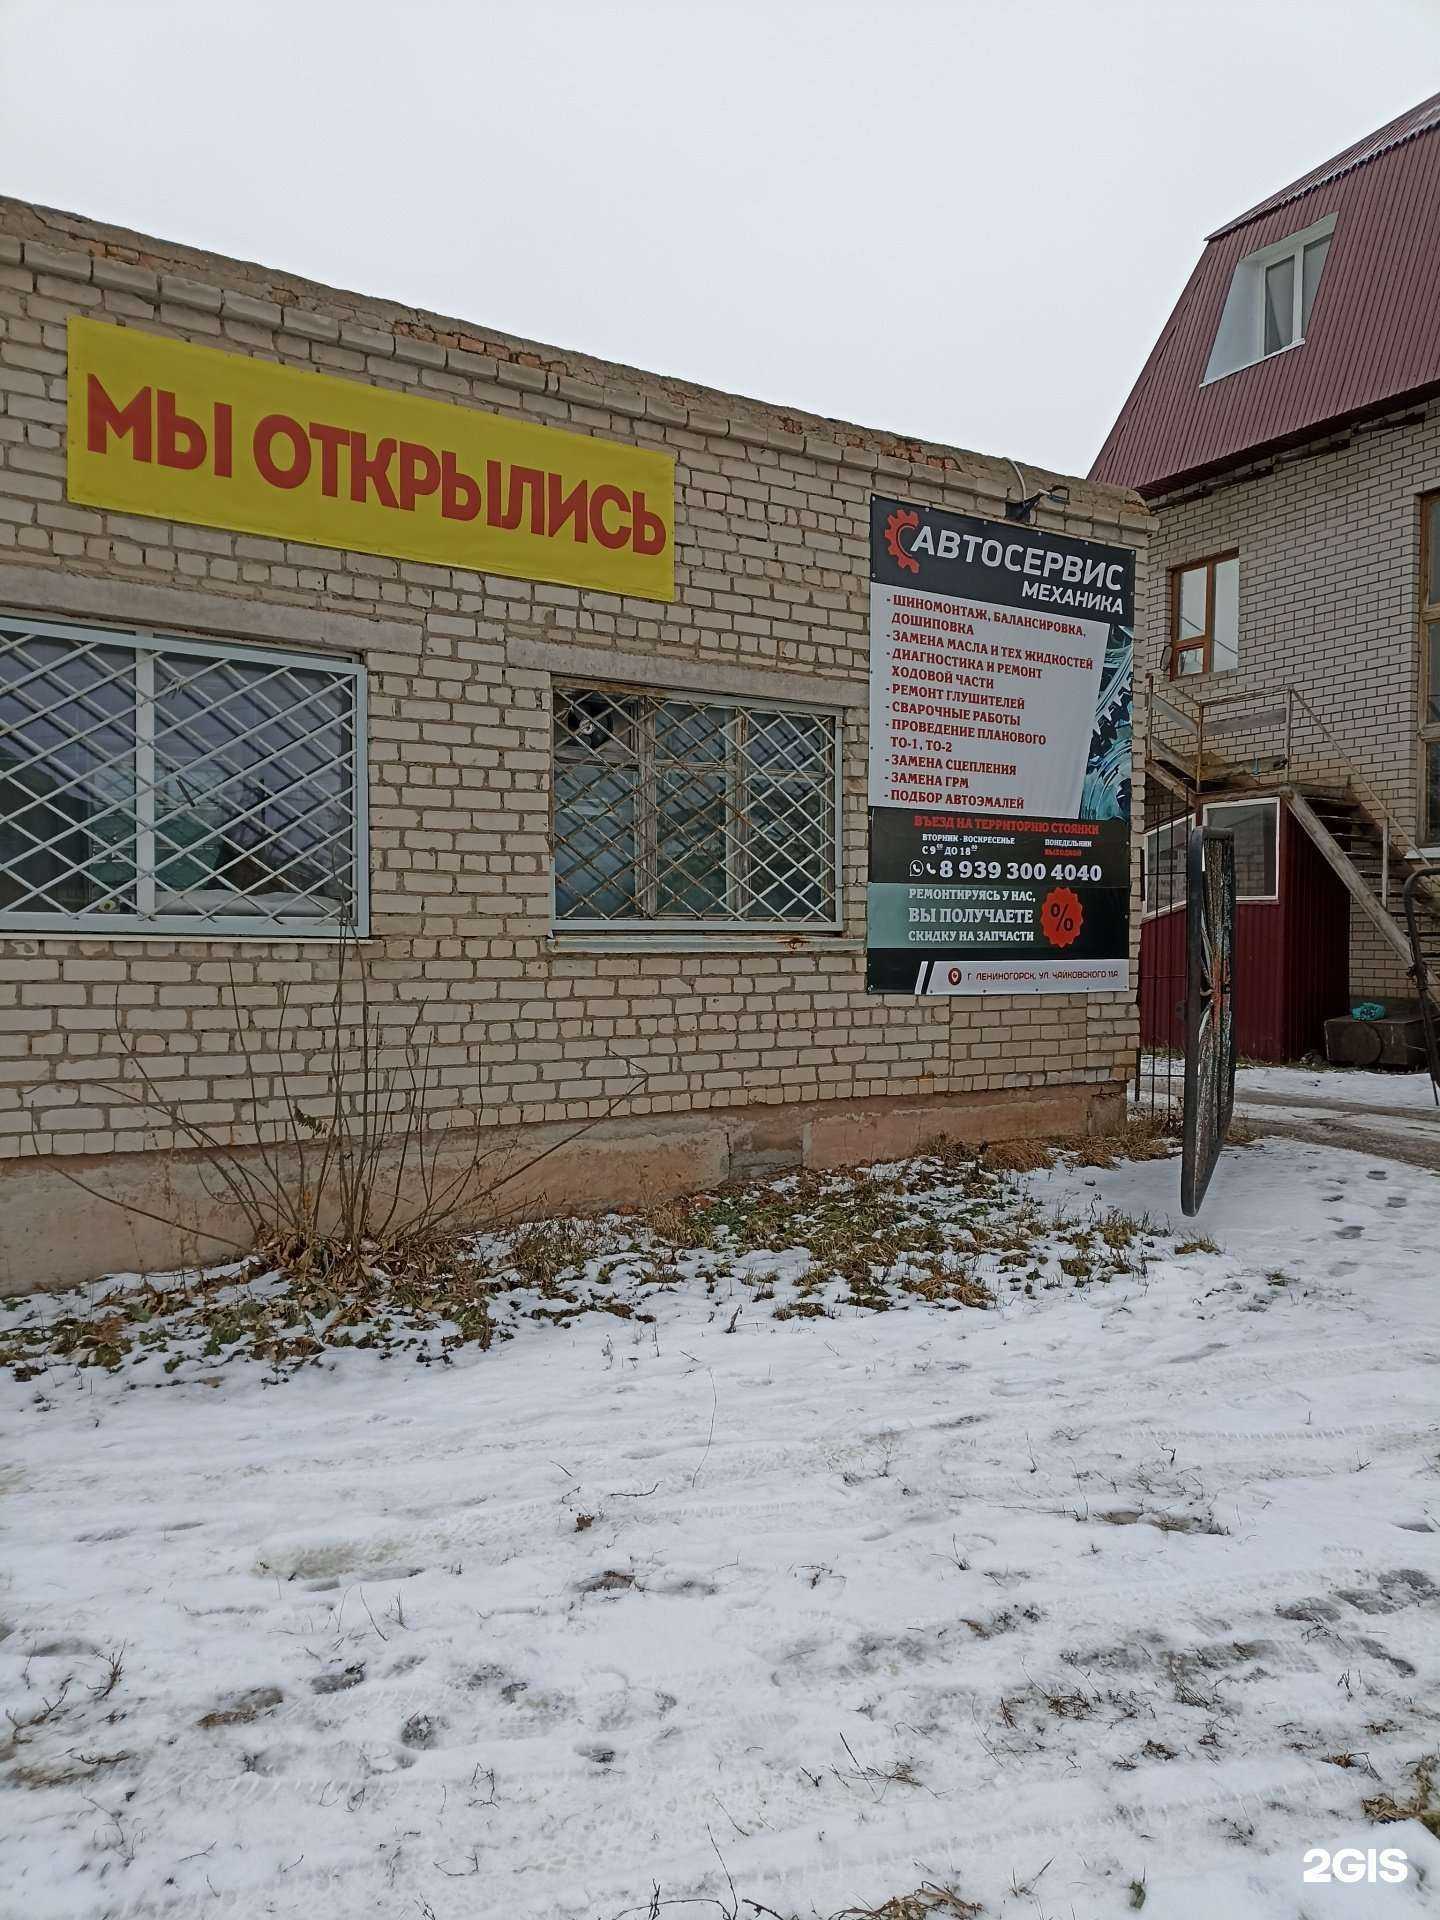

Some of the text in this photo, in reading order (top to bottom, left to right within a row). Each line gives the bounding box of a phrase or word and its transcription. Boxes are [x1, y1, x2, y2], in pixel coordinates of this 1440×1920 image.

[87, 374, 667, 556] МЫ ОТКРЫЛИСЬ
[910, 526, 1124, 591] АВТОСЕРВИС
[1021, 581, 1123, 615] МЕХАНИКА
[891, 612, 974, 635] ДОШИПОВКА
[893, 594, 1086, 637] ШИНОМОНТАЖ, БАЛАНСИРОВКА,
[892, 630, 1093, 670] ЗАМЕНА МАСЛА И ТЕХ ЖИДКОСТЕЙ
[892, 648, 1043, 679] ДИАГНОСТИКА И РЕМОНТ
[891, 665, 994, 689] ХОДОВОЙ ЧАСТИ
[891, 683, 1025, 709] РЕМОНТ ГЛУШИТЕЛЕЙ
[892, 701, 1020, 726] СВАРОЧНЫЕ РАБОТЫ
[891, 719, 1046, 745] ПРОВЕДЕНИЕ ПЛАНОВОГО
[926, 739, 952, 752] ТО-2
[891, 754, 1016, 775] ЗАМЕНА СЦЕПЛЕНИЯ
[891, 772, 969, 788] ЗАМЕНА ГРМ
[890, 789, 1024, 809] ПОДБОР АВТОЭМАЛЕЙ
[914, 815, 1100, 835] ВЪЕЗД НА ТЕРРИТОРИЮ СТОЯНКИ
[944, 846, 958, 856] ДО
[939, 860, 1102, 881] 8 939 300 4040
[908, 888, 1036, 903] РЕМОНТИРУЯСЬ У НАС,
[908, 907, 1034, 923] ВЫ ПОЛУЧАЕТЕ
[908, 930, 1034, 943] СКИДКУ НА ЗАПЧАСТИ
